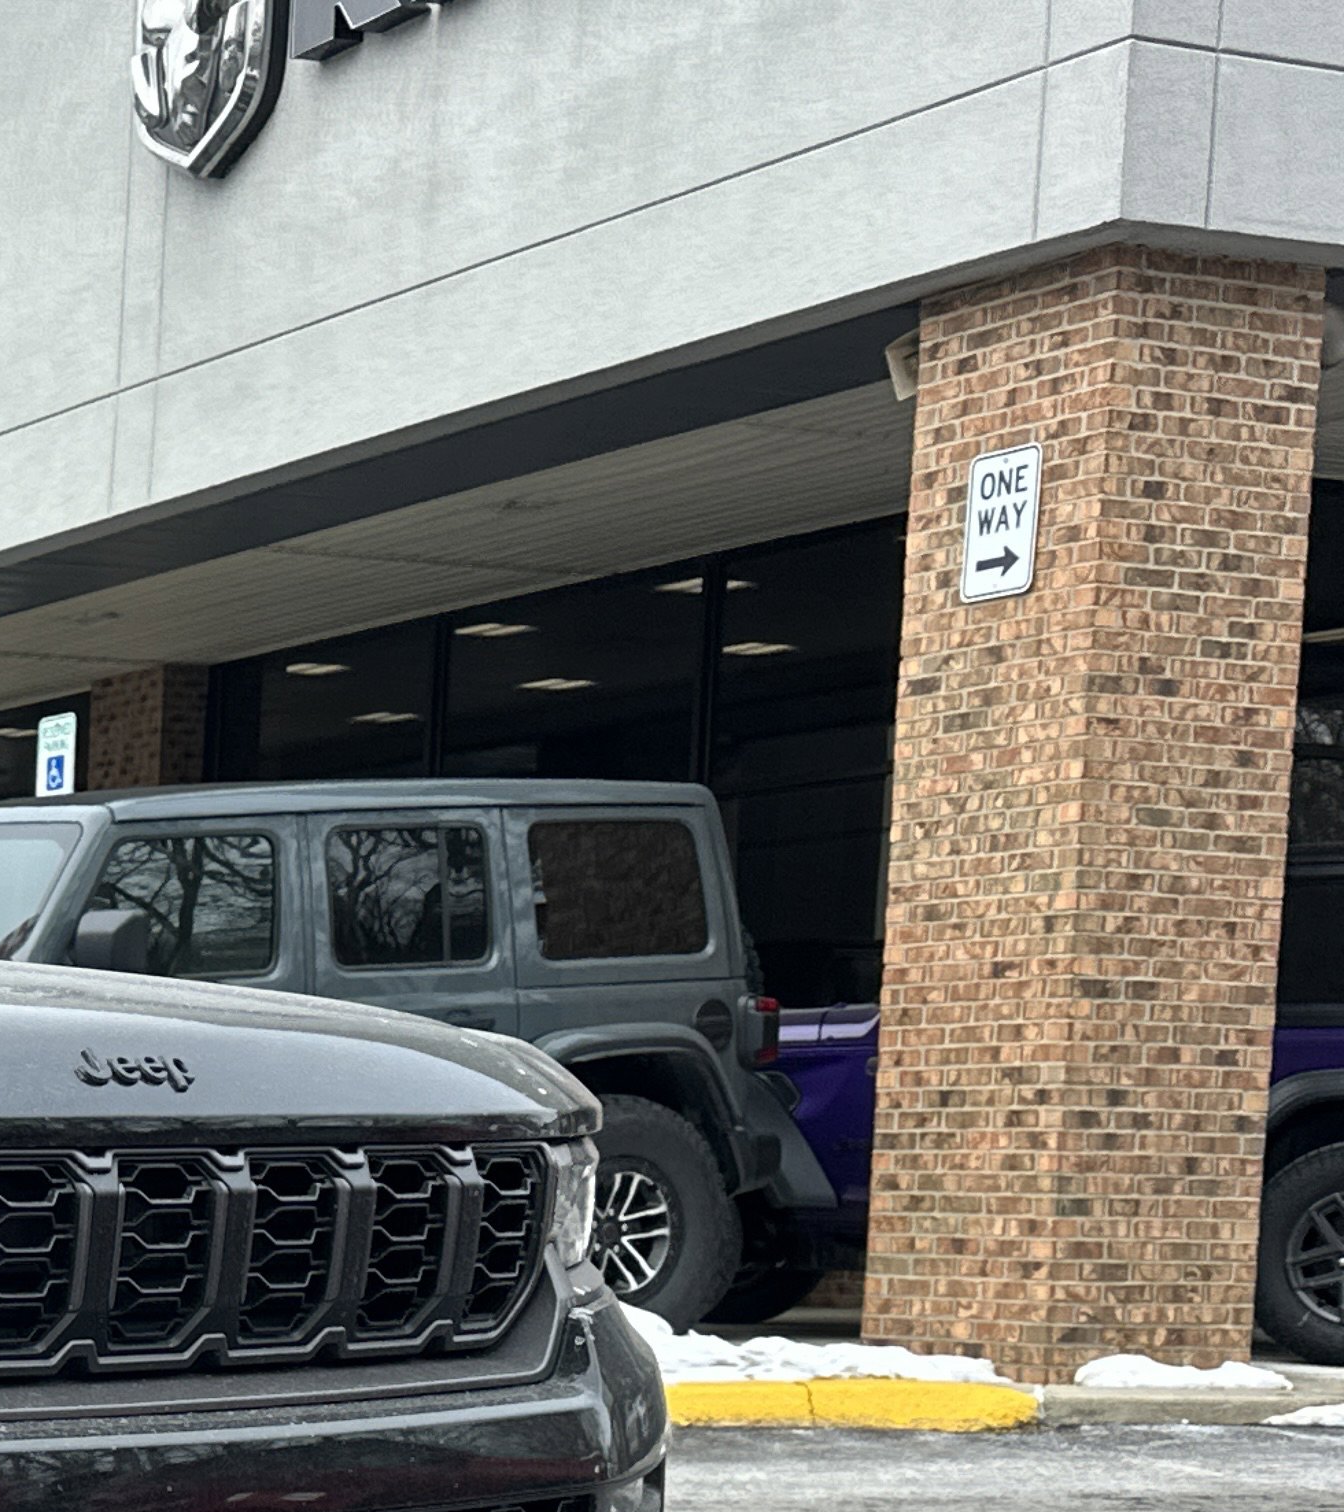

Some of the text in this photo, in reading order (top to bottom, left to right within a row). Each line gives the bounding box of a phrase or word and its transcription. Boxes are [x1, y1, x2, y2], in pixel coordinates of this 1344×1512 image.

[980, 464, 1029, 500] ONE
[978, 500, 1027, 537] WAY
[74, 1048, 196, 1093] Jeep
